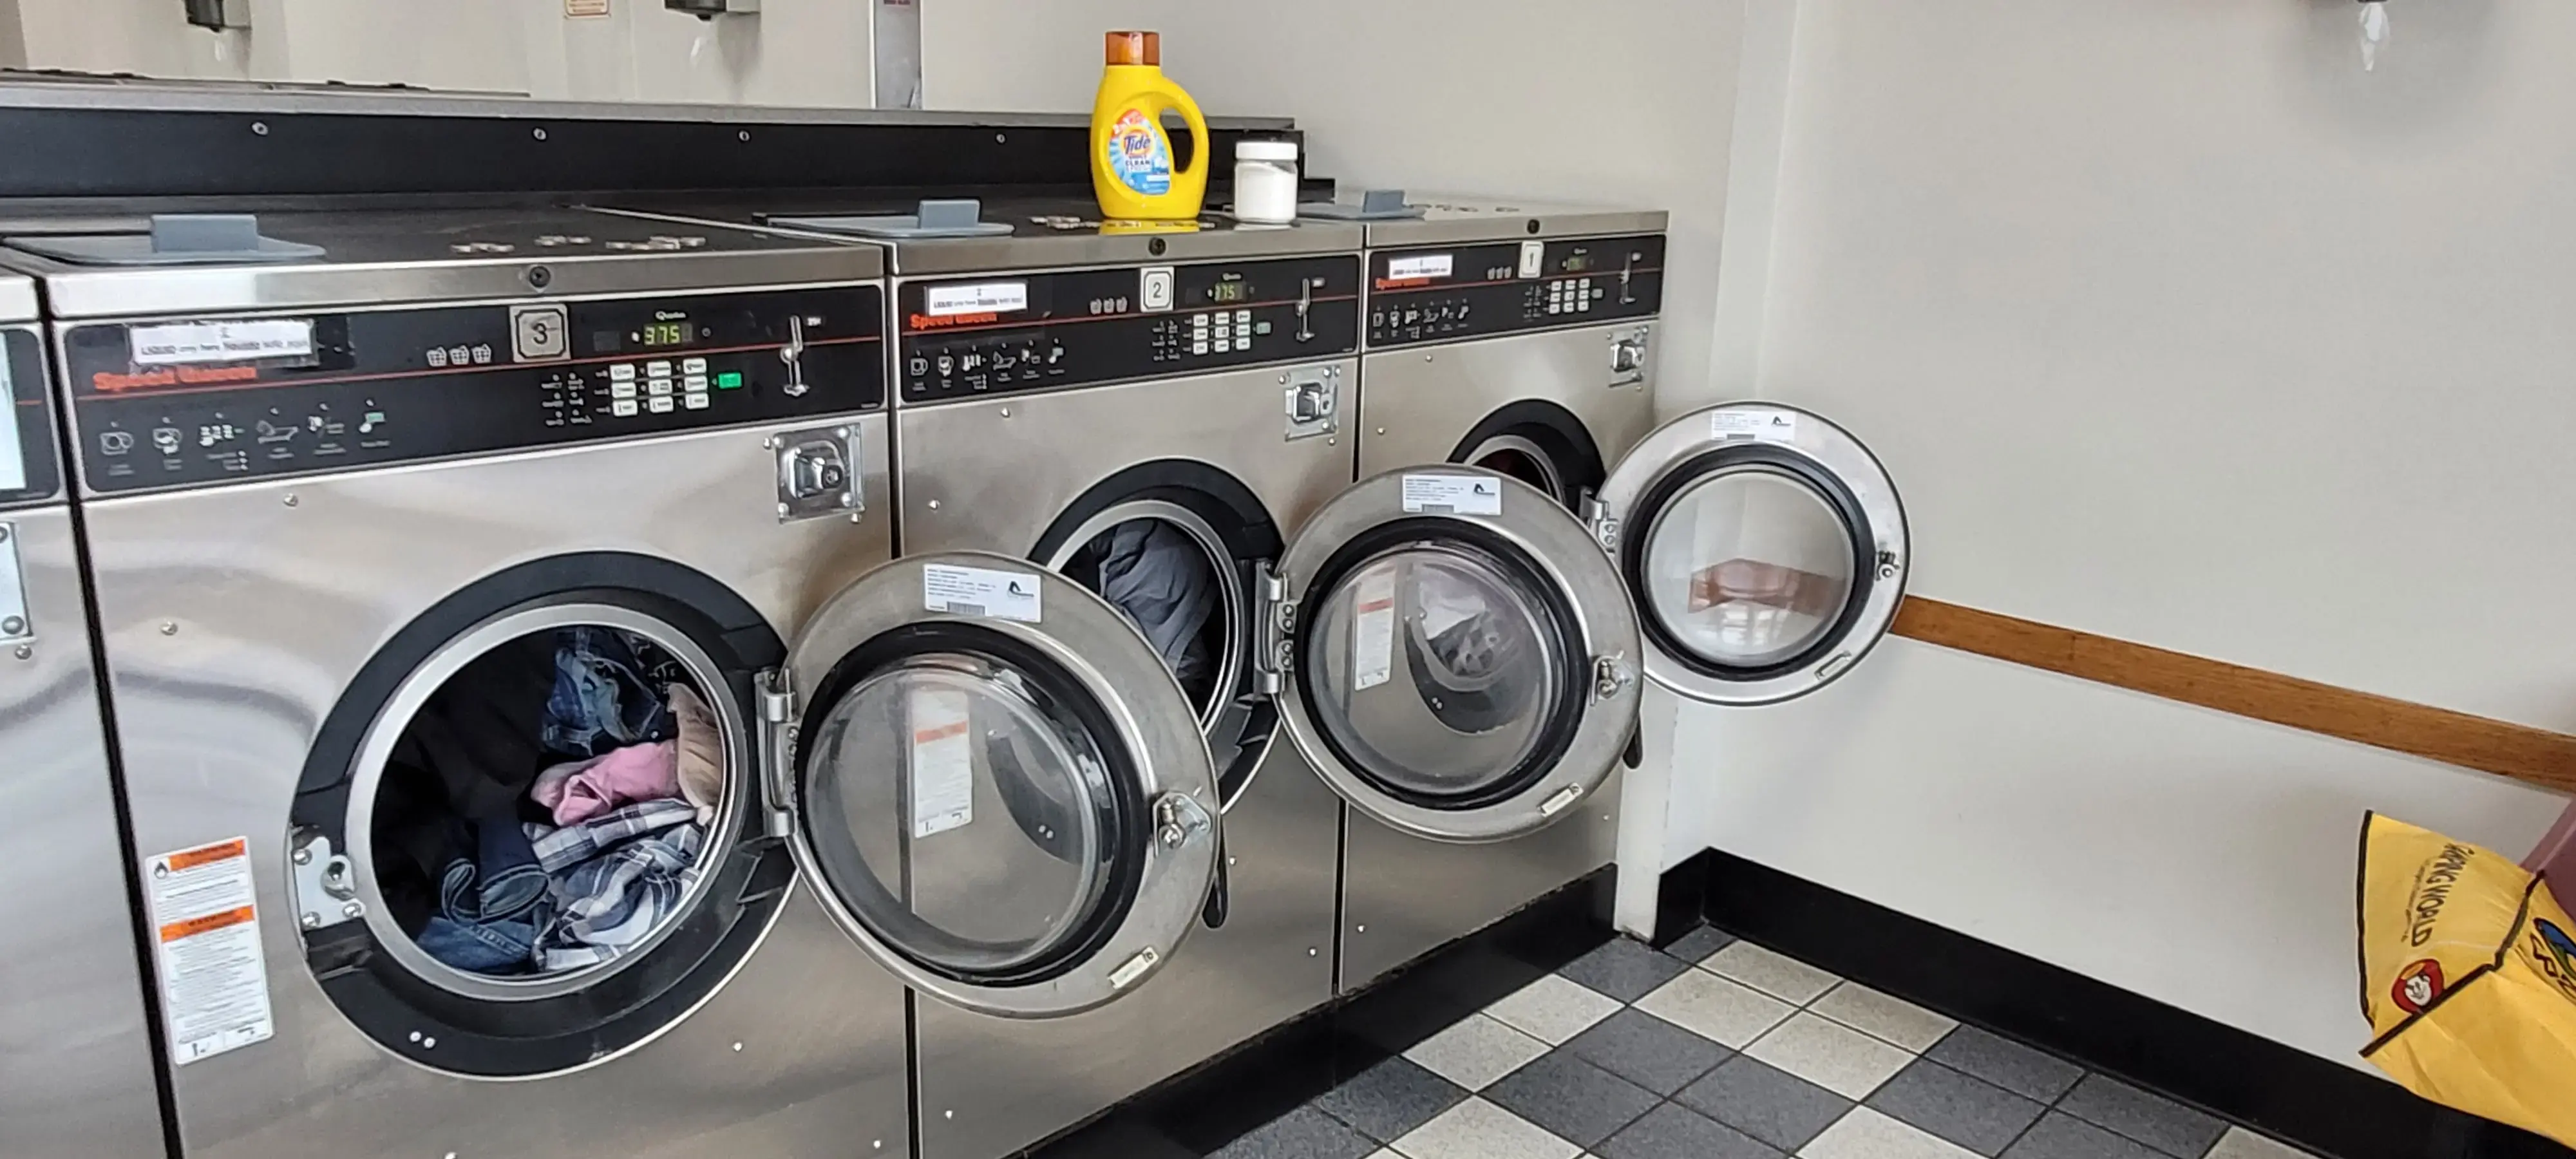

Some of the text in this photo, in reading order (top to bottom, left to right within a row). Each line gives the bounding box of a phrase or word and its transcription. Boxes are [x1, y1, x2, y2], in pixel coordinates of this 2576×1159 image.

[1124, 135, 1150, 155] Tide
[1530, 252, 1534, 267] 1
[1153, 282, 1162, 298] 2
[533, 323, 547, 344] 3
[645, 325, 681, 346] 375
